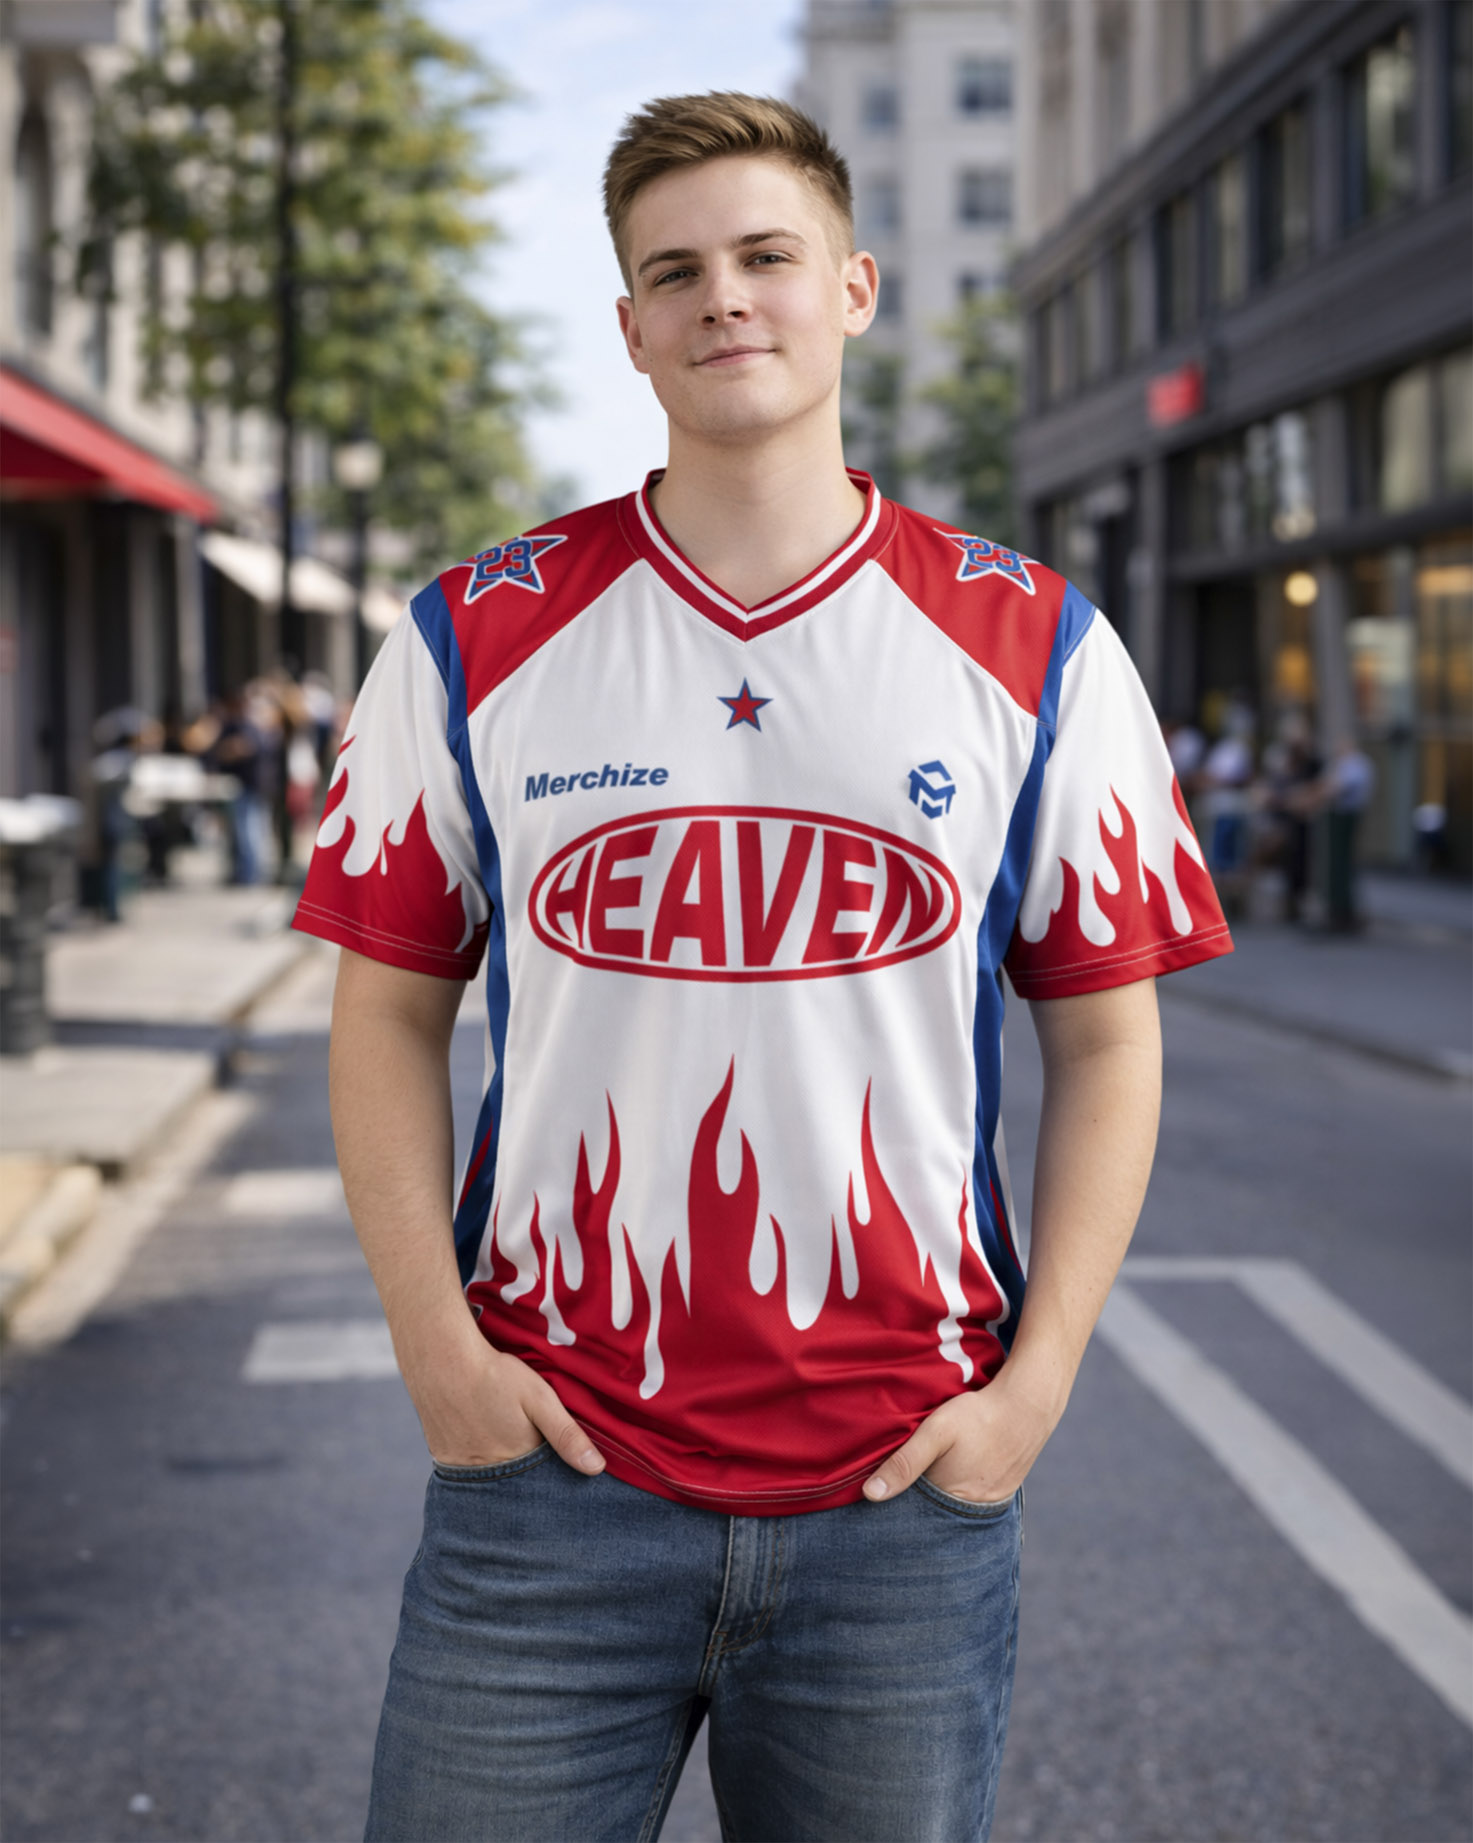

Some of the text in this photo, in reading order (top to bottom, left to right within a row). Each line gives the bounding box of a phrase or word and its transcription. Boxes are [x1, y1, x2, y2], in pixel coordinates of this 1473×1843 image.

[475, 539, 532, 580] 23
[524, 762, 669, 802] Merchize
[545, 820, 945, 967] HEAVEN
